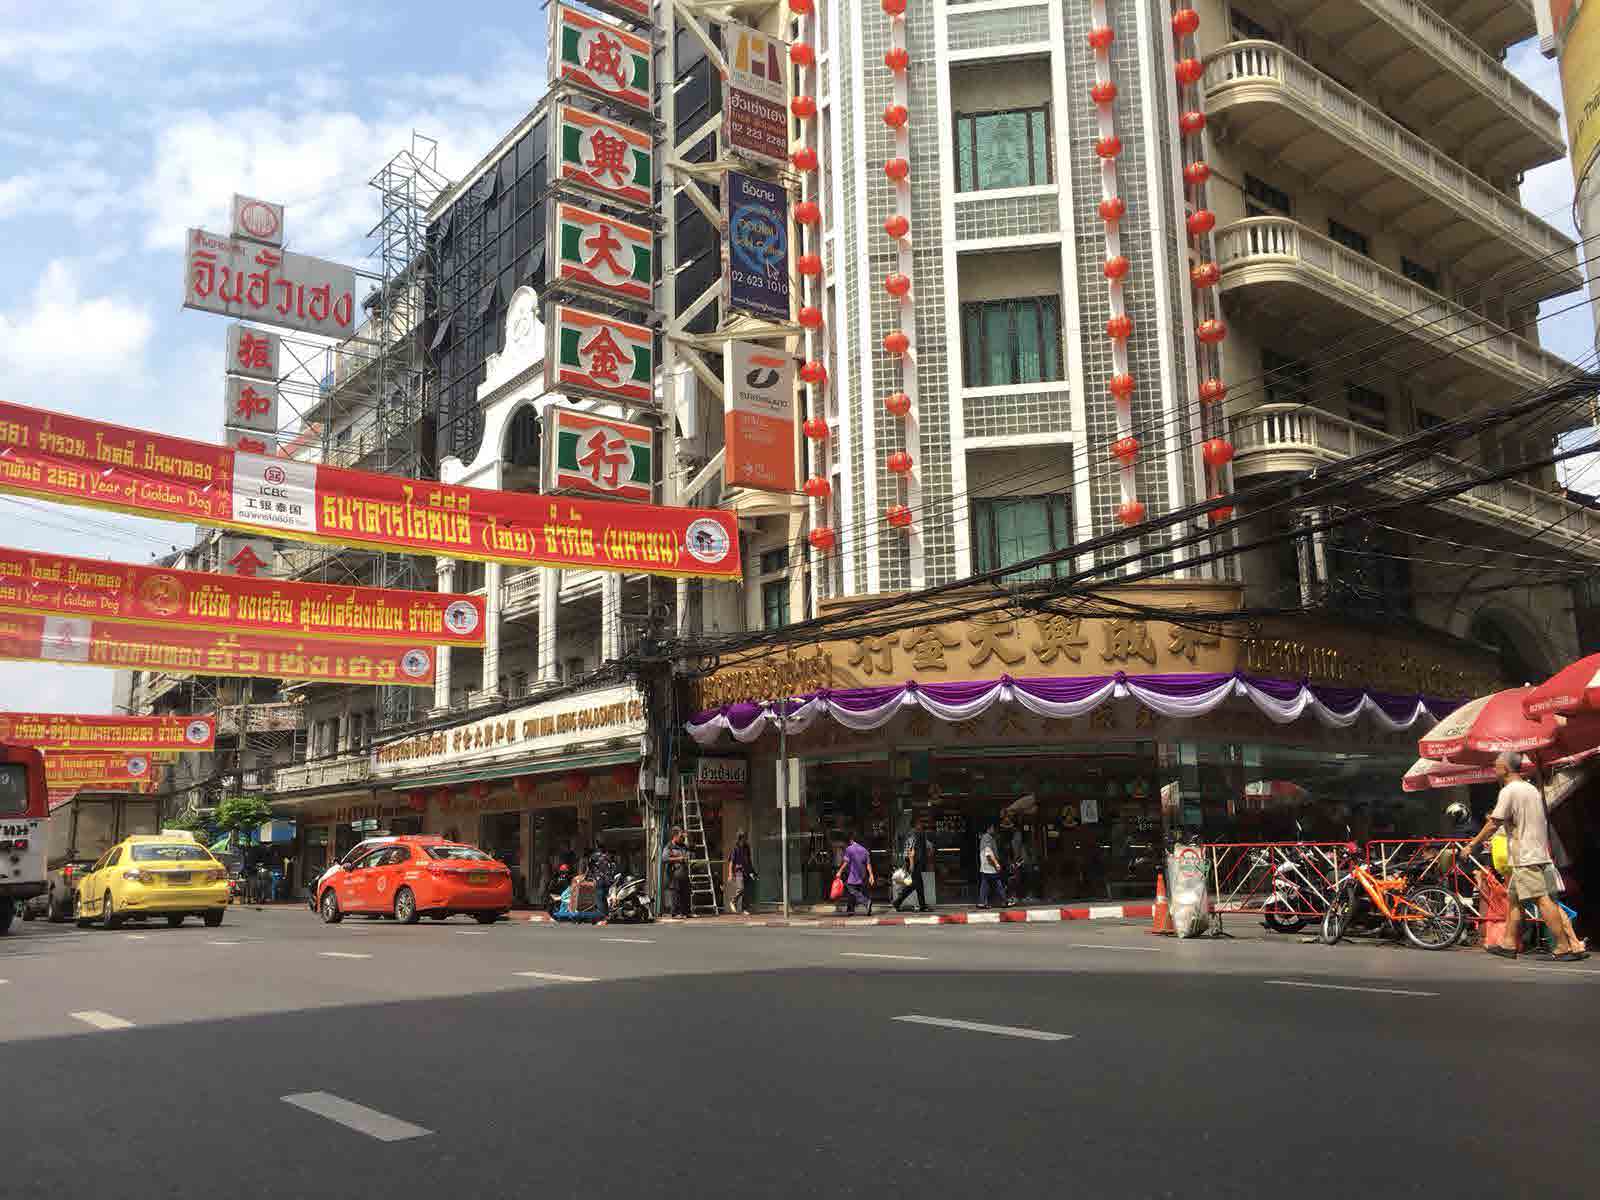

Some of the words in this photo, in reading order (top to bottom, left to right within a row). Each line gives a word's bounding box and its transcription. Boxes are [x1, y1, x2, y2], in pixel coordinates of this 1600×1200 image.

[732, 270, 743, 283] 02
[747, 276, 763, 288] 623
[767, 280, 788, 295] 1010
[90, 473, 120, 495] Year
[141, 483, 184, 504] Golden
[188, 490, 213, 515] Dog
[258, 486, 289, 499] ICBC
